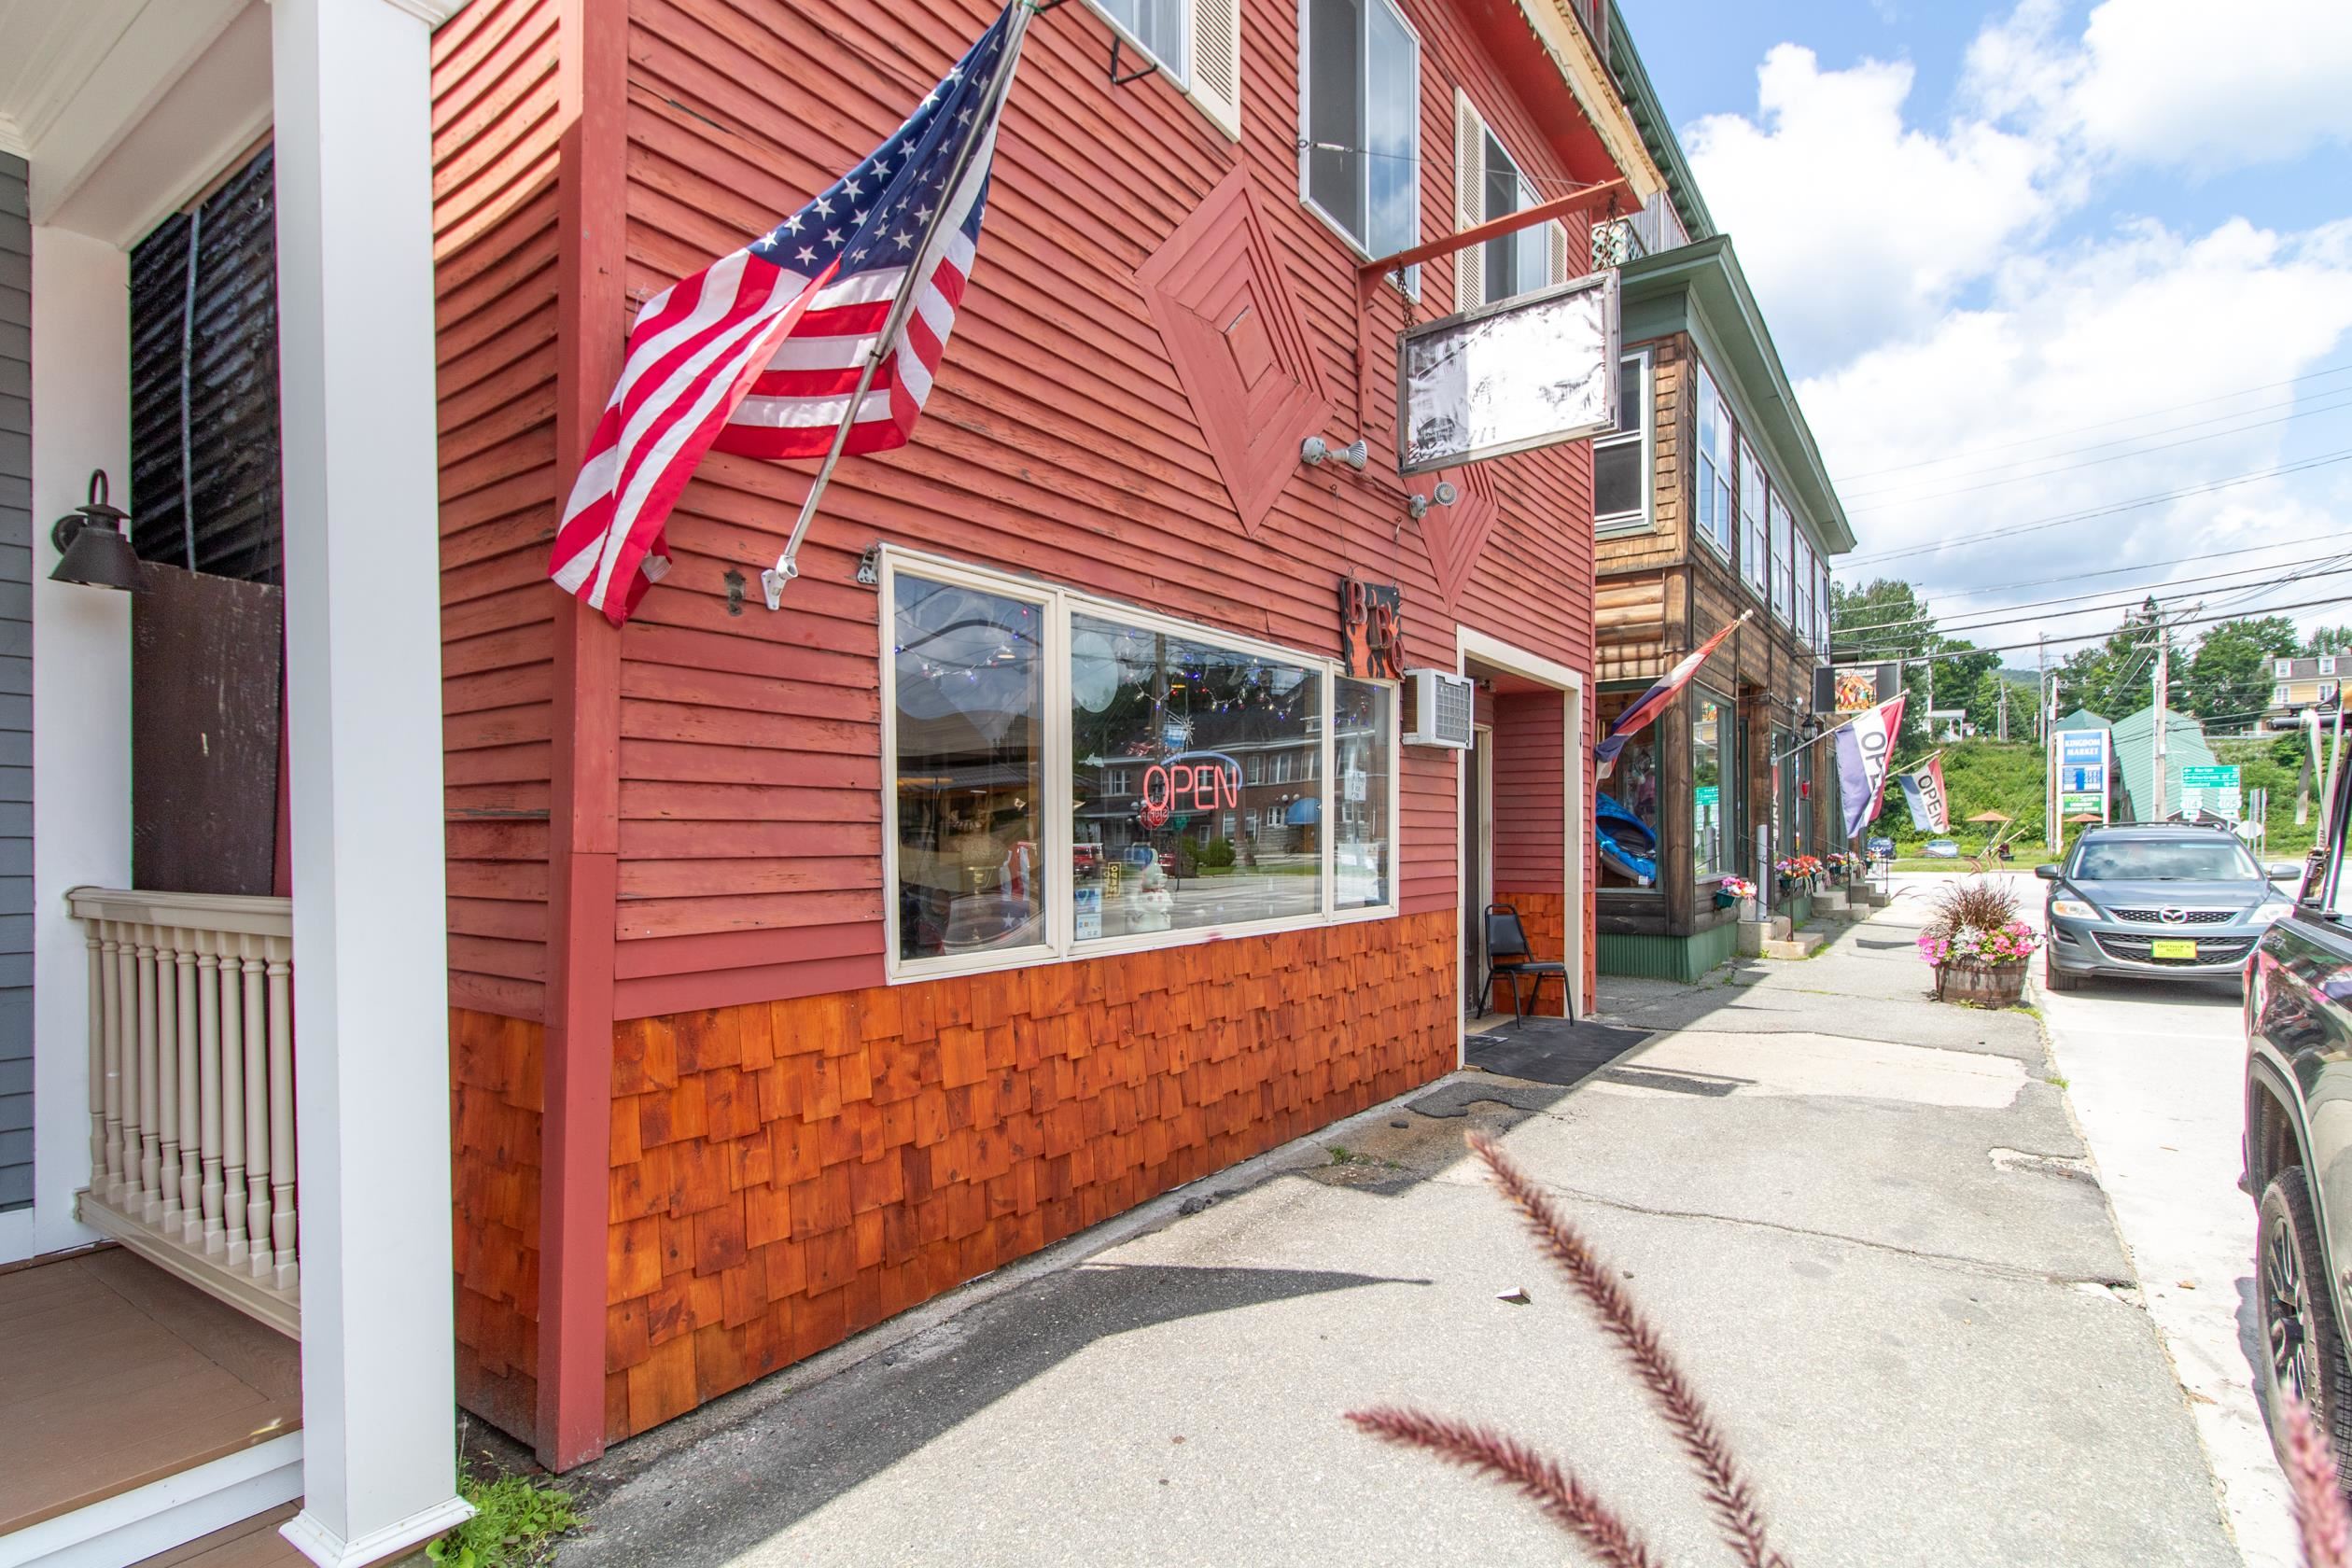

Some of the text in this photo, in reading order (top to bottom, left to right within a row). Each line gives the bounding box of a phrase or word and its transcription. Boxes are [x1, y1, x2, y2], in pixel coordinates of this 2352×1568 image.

[1346, 581, 1406, 682] BBQ
[2065, 738, 2101, 748] KINGDOM
[2066, 748, 2099, 756] MARKET
[1143, 764, 1238, 810] OPEN
[1918, 775, 1943, 827] OPEN
[2184, 799, 2198, 807] 114
[2221, 799, 2238, 808] 105
